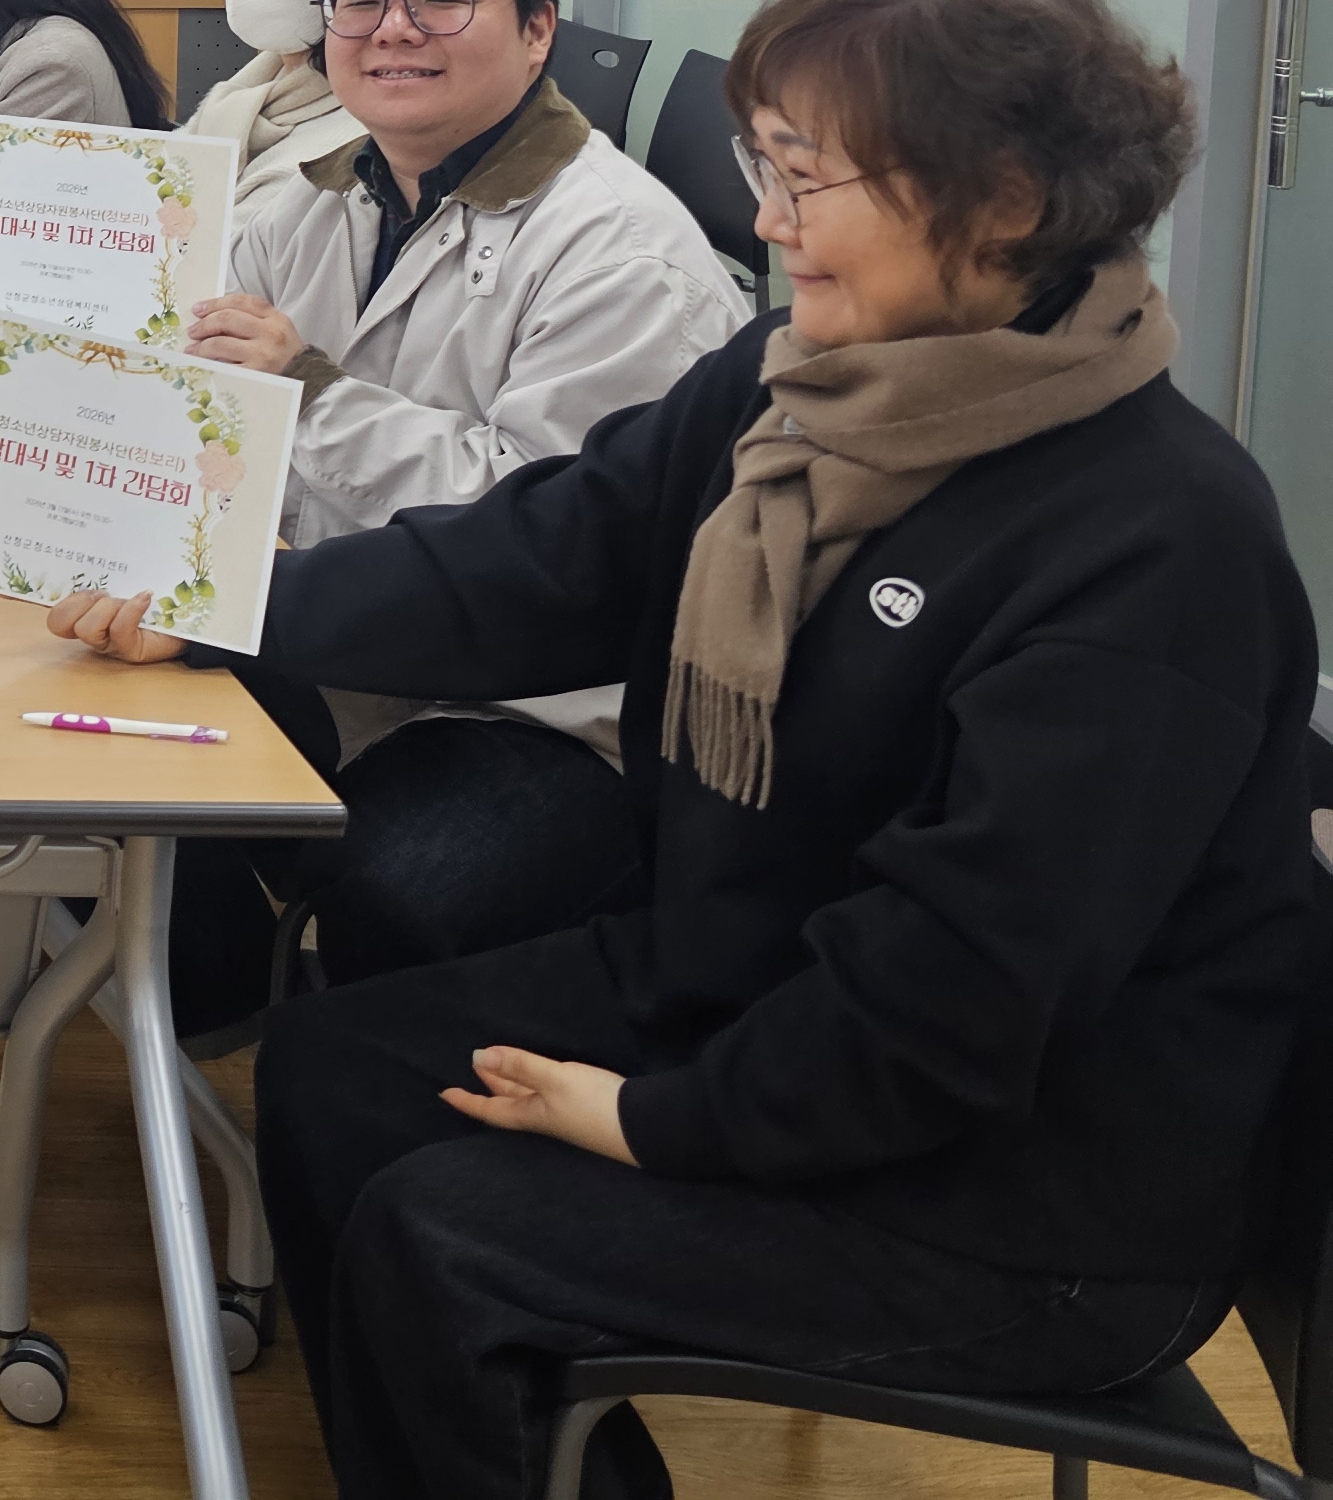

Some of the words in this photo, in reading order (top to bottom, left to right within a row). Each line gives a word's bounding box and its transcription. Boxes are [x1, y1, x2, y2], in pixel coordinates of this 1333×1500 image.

[56, 182, 89, 196] 2026년
[42, 221, 61, 243] 및
[66, 224, 94, 246] 1차
[98, 228, 156, 254] 간담회
[76, 405, 116, 425] 2026년
[54, 451, 77, 480] 및
[83, 459, 118, 491] 1차
[121, 469, 193, 508] 간담회
